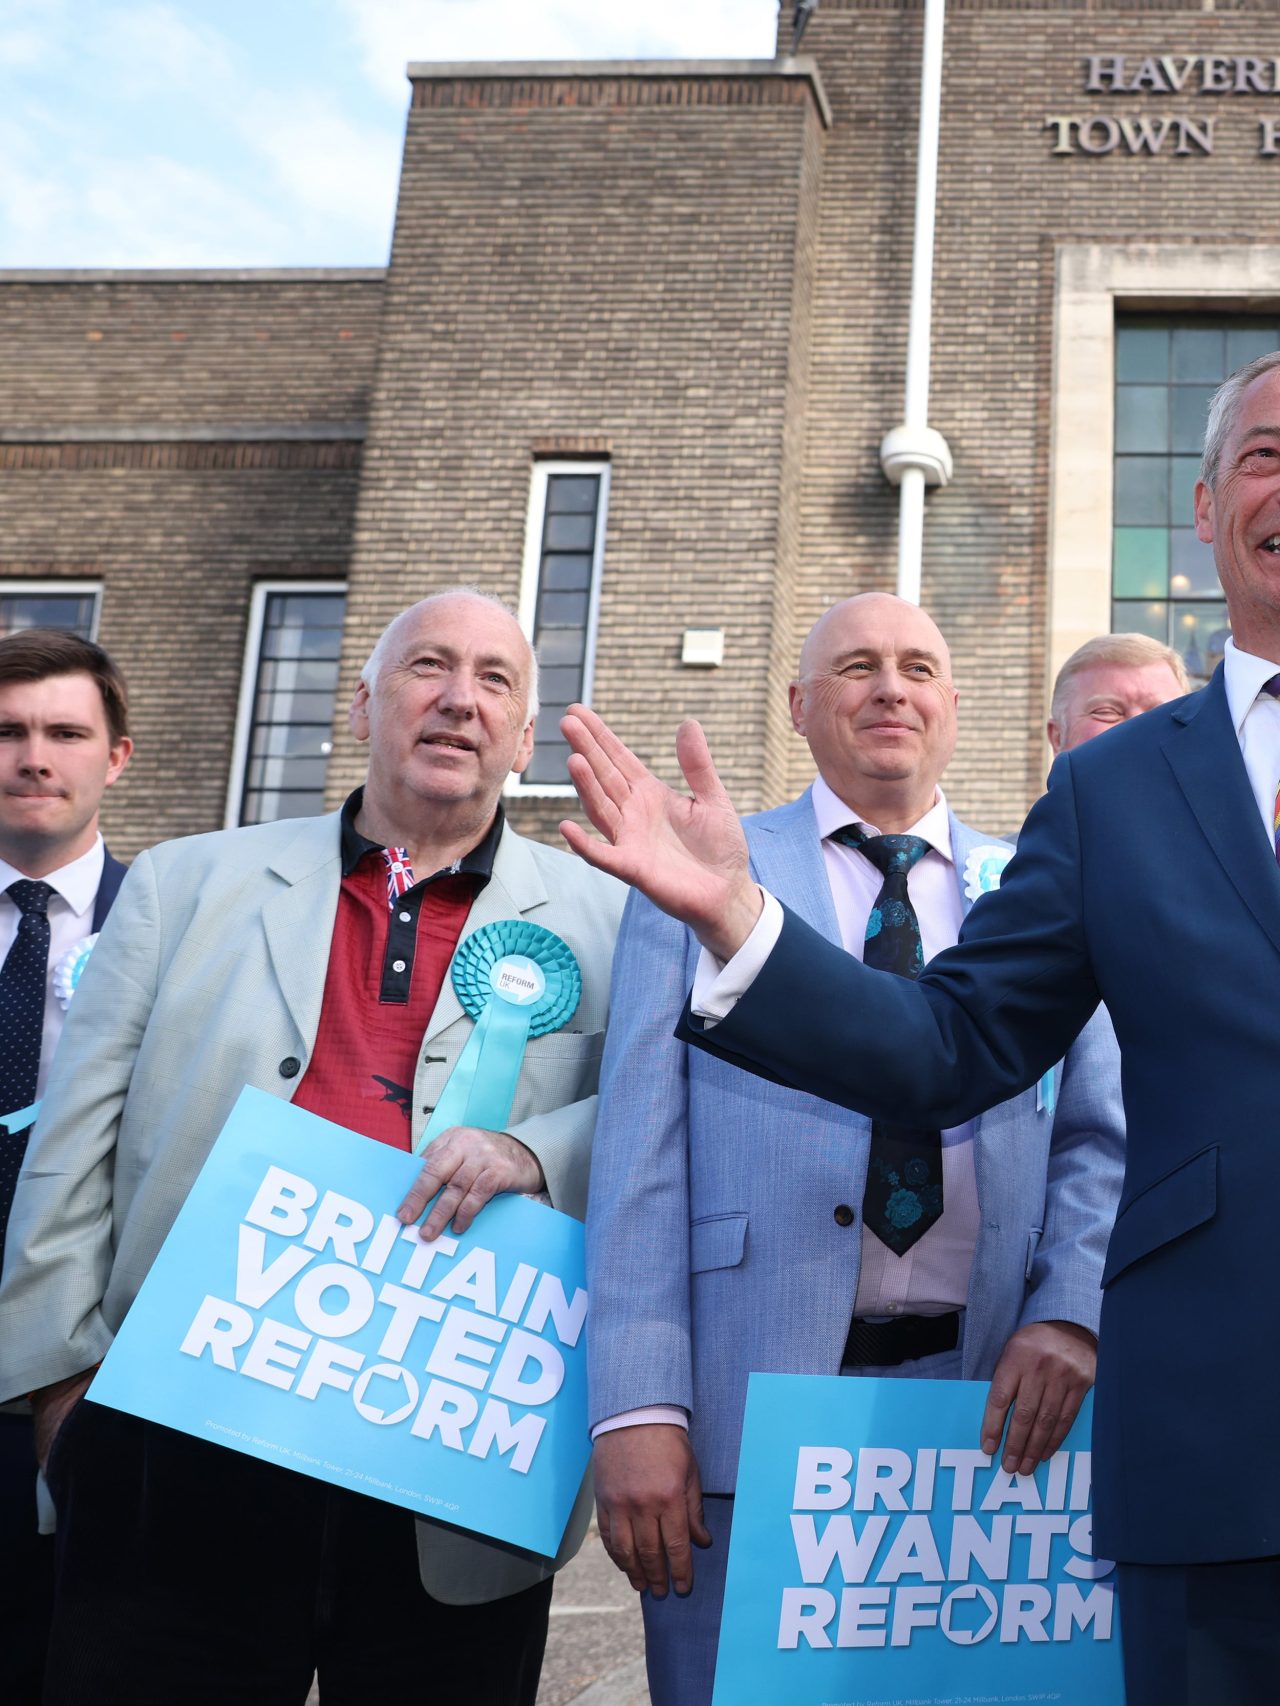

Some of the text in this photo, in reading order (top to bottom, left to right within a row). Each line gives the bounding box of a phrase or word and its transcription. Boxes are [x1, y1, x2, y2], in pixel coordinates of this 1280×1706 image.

[1045, 116, 1216, 156] TOWN
[500, 980, 510, 989] UK
[501, 973, 535, 990] REFORM
[244, 1164, 588, 1348] BRITAIN
[236, 1224, 565, 1406] VOTED
[179, 1295, 546, 1474] REFORM
[789, 1514, 1116, 1583] WANTS
[777, 1582, 1115, 1650] REFORM
